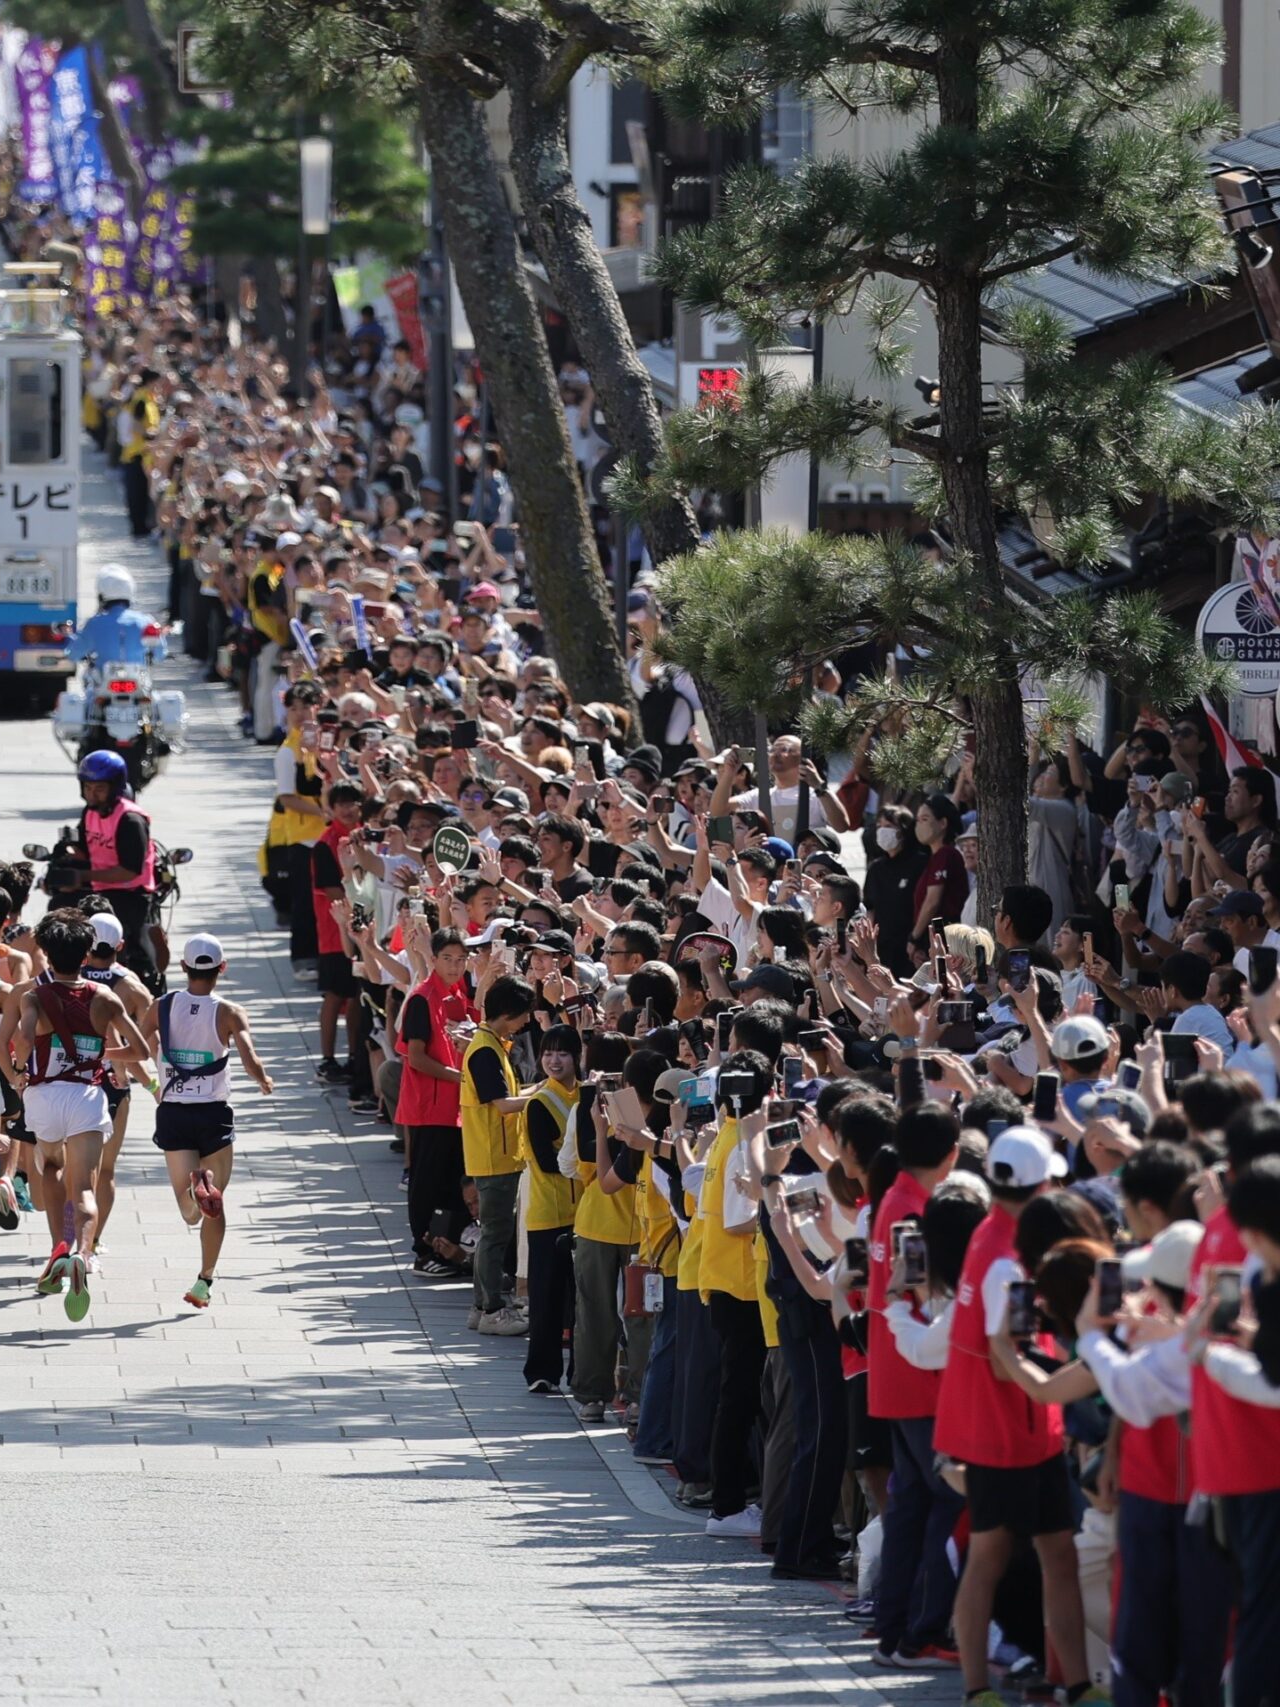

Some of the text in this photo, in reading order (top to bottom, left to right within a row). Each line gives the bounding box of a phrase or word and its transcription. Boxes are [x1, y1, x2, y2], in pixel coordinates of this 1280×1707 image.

[16, 514, 27, 539] 1
[87, 970, 112, 979] TOYO
[171, 1081, 201, 1094] 18-1
